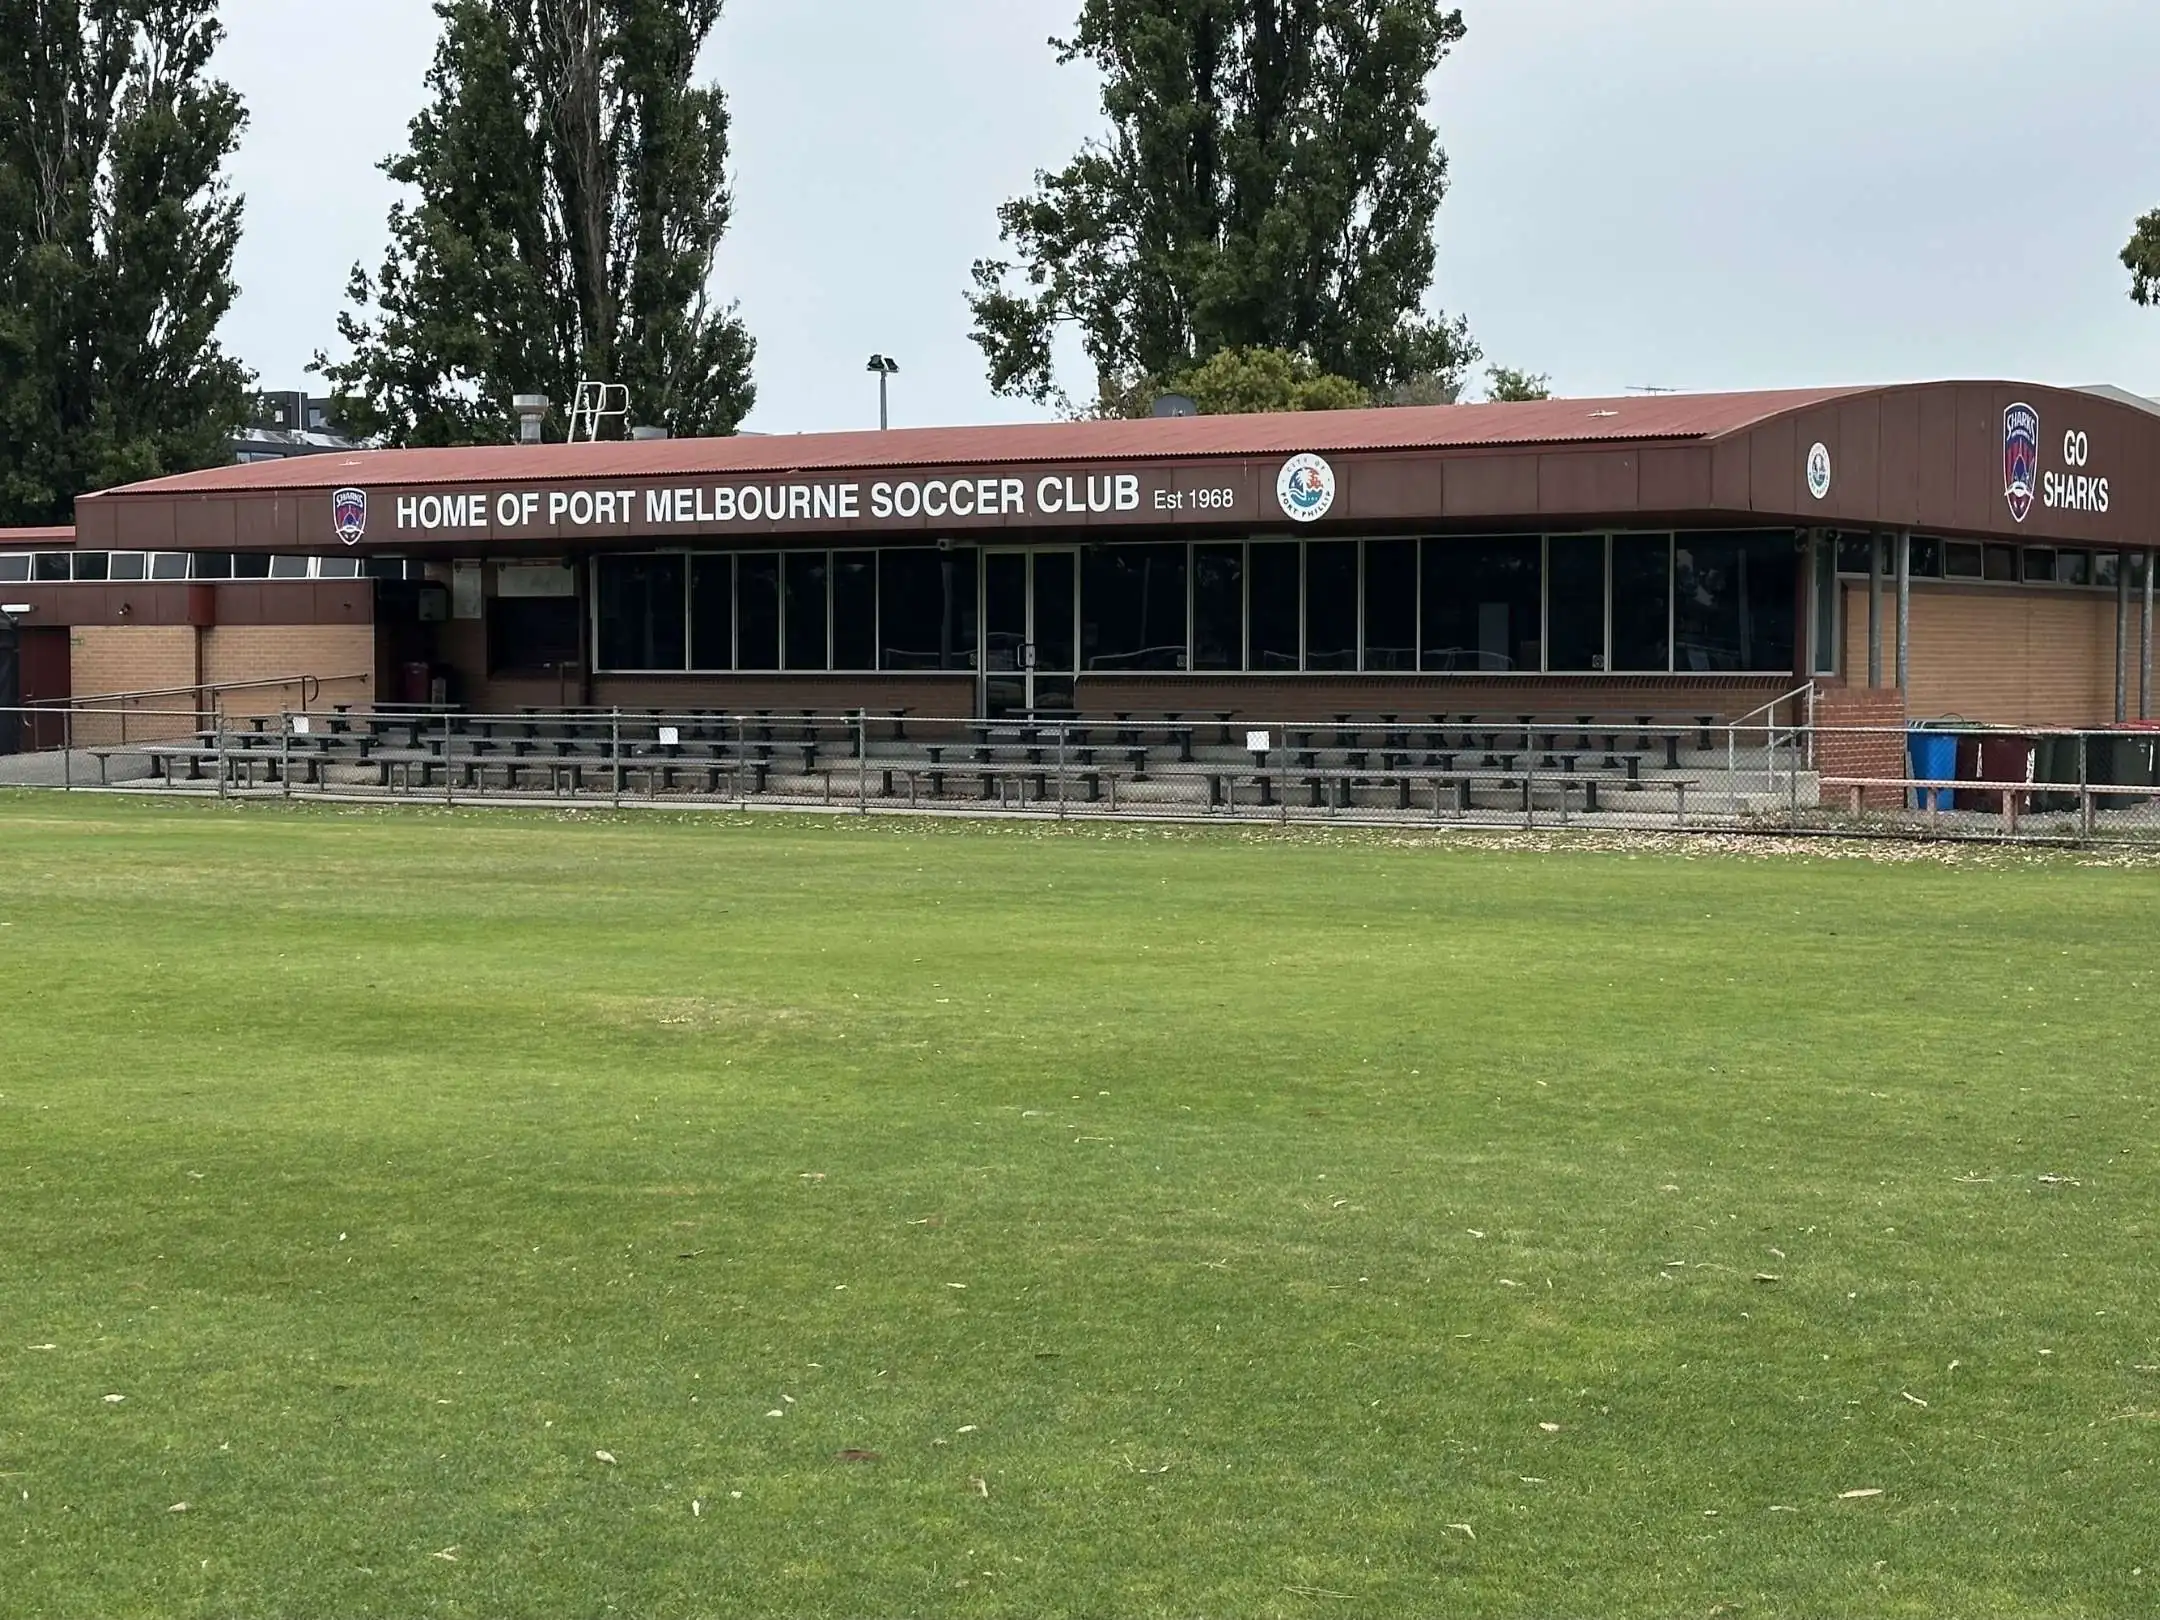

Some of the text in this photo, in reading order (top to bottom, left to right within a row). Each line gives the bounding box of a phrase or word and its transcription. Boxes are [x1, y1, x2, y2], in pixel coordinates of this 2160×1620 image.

[2006, 411, 2035, 445] SHARKS
[2063, 430, 2088, 467] GO
[336, 492, 364, 508] SHARKS
[397, 474, 1234, 529] HOME OF PORT MELBOURNE SOCCER CLUB Est 1968
[1281, 491, 1331, 517] PORT PHILLIP
[2043, 470, 2109, 513] SHARKS
